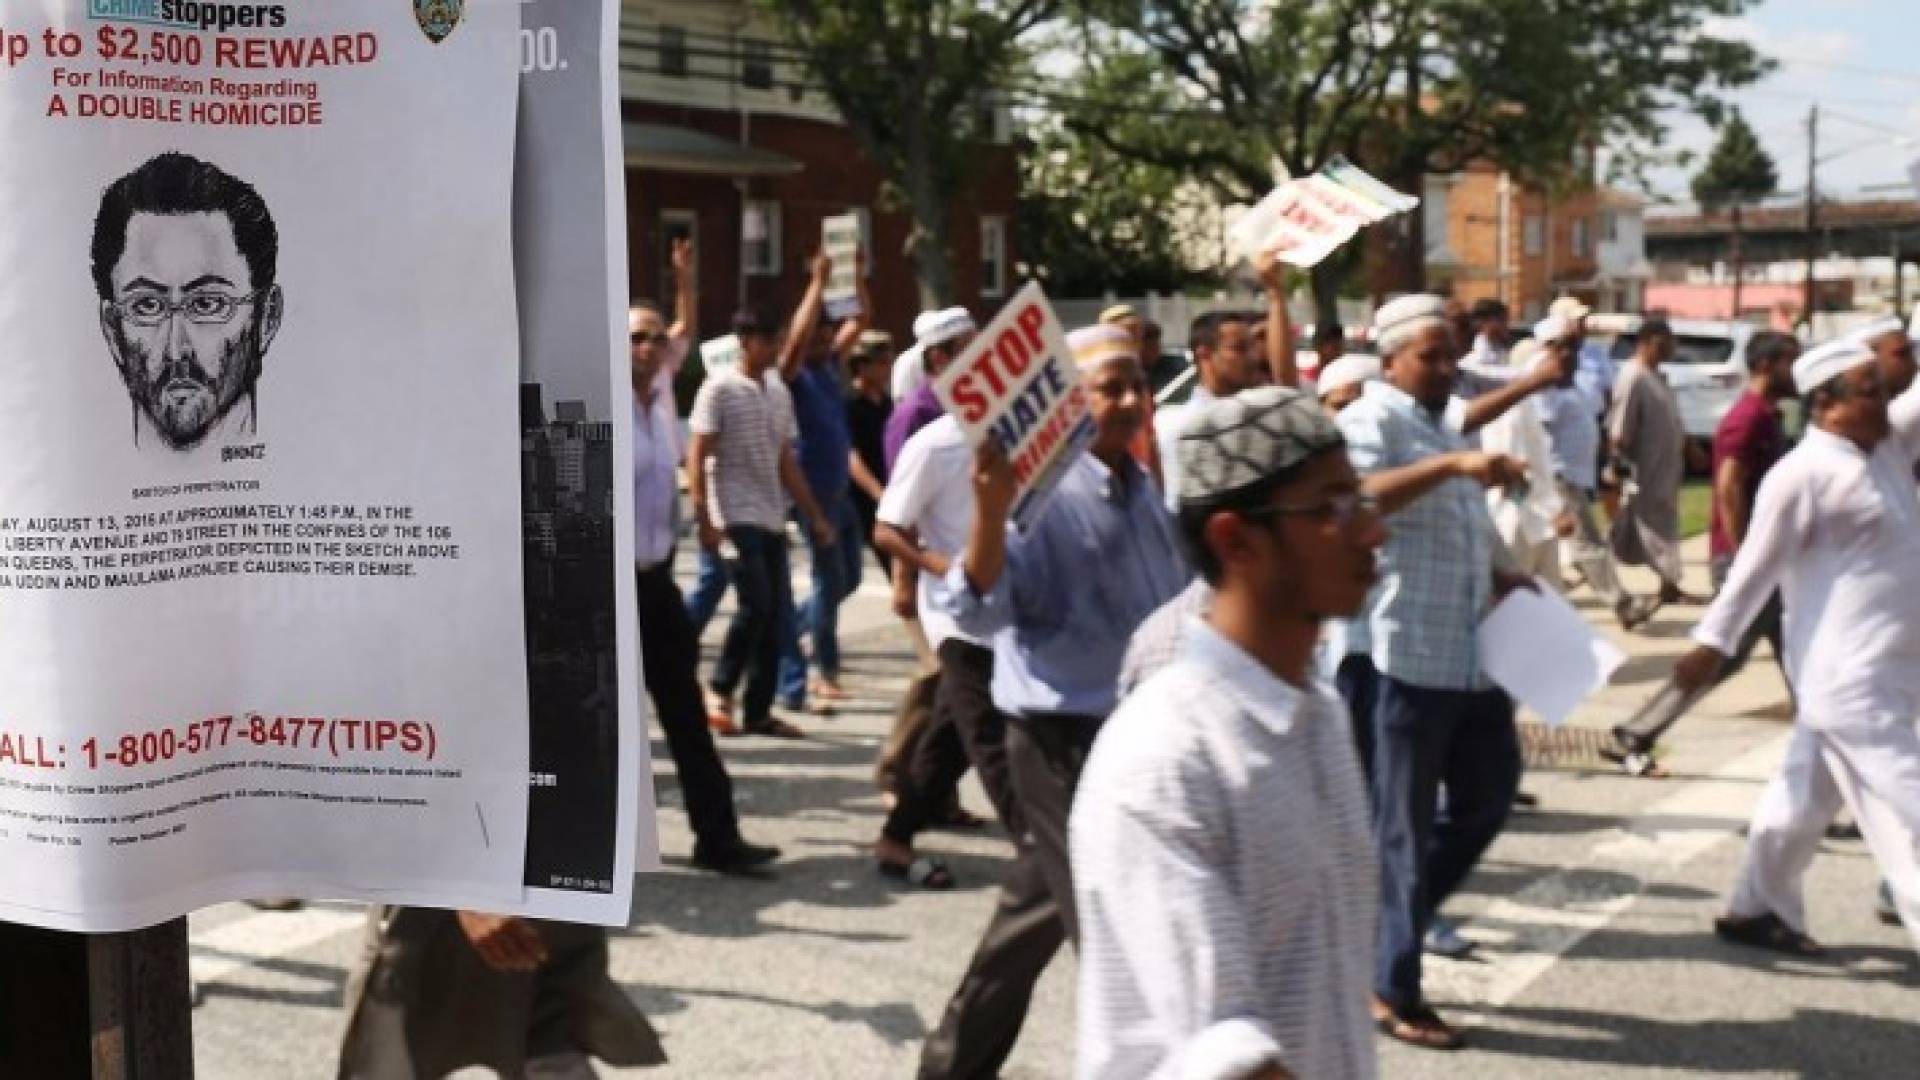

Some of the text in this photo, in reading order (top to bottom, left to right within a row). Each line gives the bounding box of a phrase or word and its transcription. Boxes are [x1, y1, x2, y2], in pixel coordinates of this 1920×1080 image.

[0, 24, 378, 68] p to $2,500 REWARD
[53, 68, 318, 98] For Information Regarding
[46, 95, 323, 125] A DOUBLE HOMICIDE
[952, 303, 1045, 424] STOP
[988, 356, 1066, 453] HATE
[1012, 387, 1087, 484] RIMES
[27, 518, 92, 532] AUGUST
[124, 515, 155, 528] 2016
[158, 510, 173, 525] AT
[176, 505, 295, 521] APPROXIMATELY
[366, 507, 381, 519] IN
[385, 507, 414, 519] THE
[5, 537, 65, 551] LIBERTY
[70, 534, 137, 550] AVENUE
[142, 531, 168, 546] AND
[185, 524, 239, 541] STREET
[242, 524, 257, 538] IN
[262, 524, 292, 538] THE
[294, 524, 366, 538] CONFINES
[369, 525, 389, 538] OF
[394, 526, 422, 538] THE
[84, 556, 116, 568] THE
[121, 545, 214, 568] PERPETRATOR
[216, 543, 292, 557] DEPICTED
[296, 543, 311, 556] IN
[315, 543, 341, 557] THE
[345, 543, 403, 557] SKETCH
[407, 545, 460, 559] ABOVE
[64, 575, 100, 589] AND
[244, 561, 311, 574] CAUSING
[314, 562, 354, 576] THEIR
[0, 714, 437, 769] ALL: 1-800-577-8477(TIPS)
